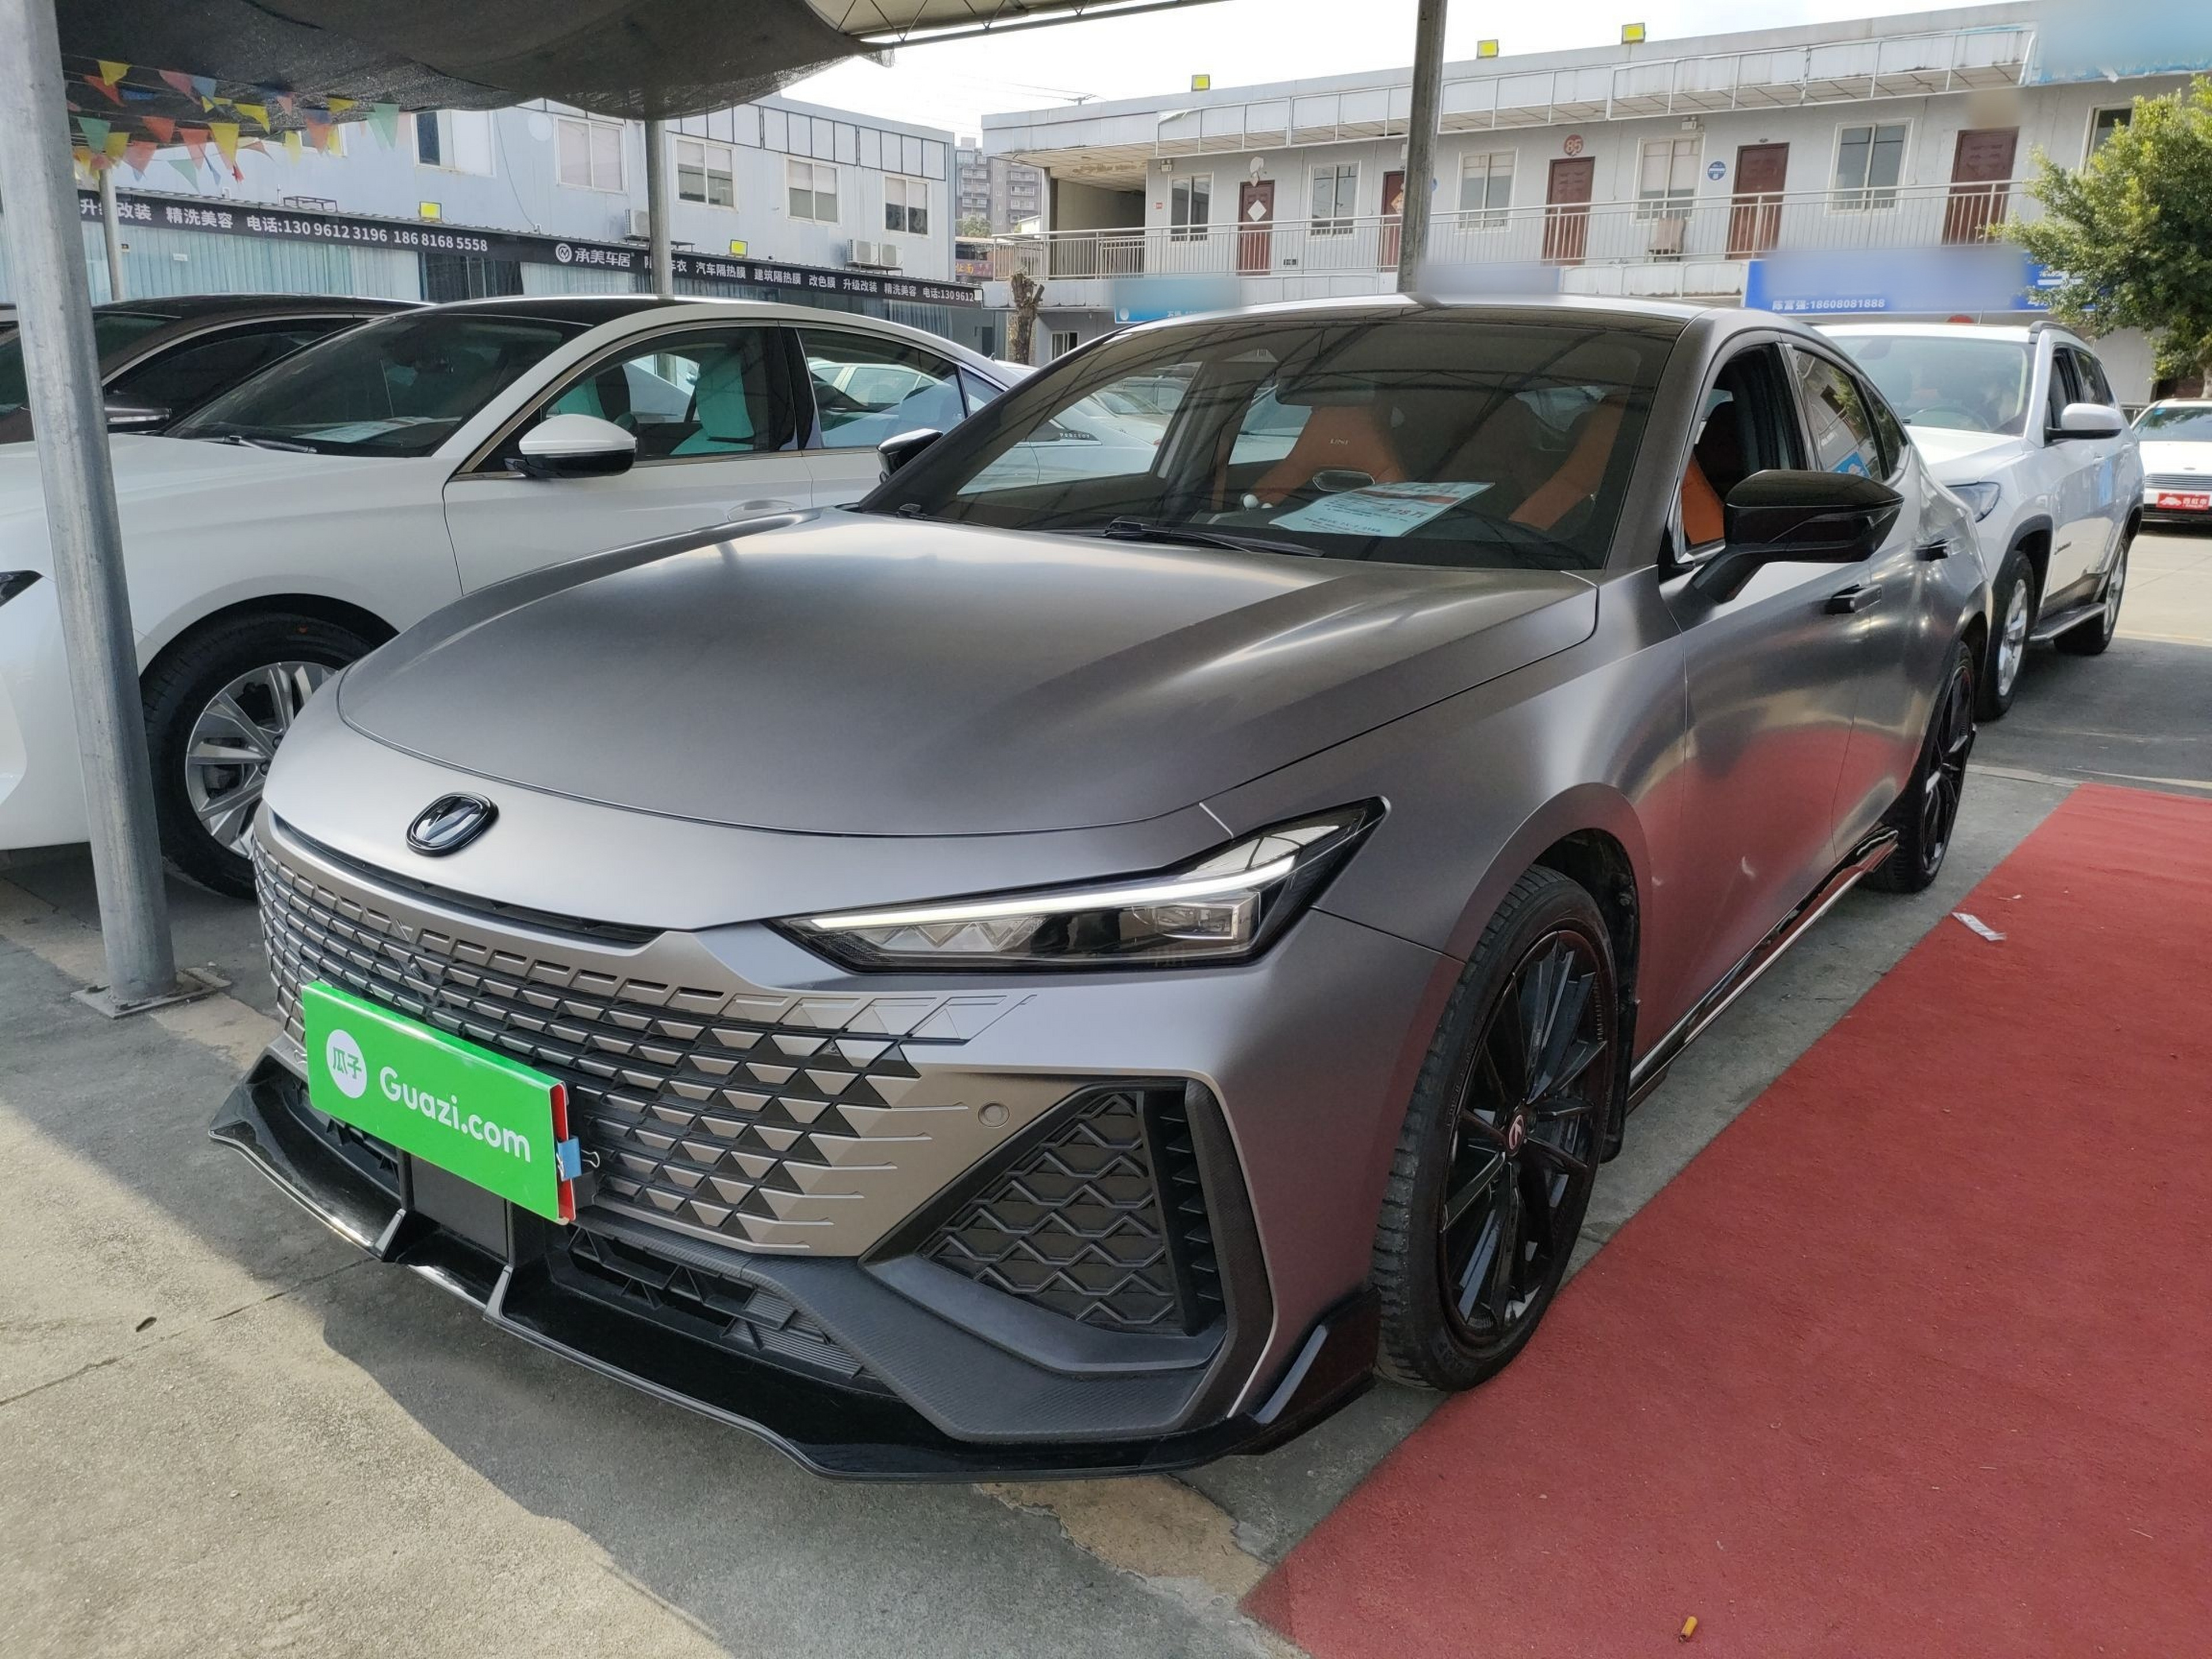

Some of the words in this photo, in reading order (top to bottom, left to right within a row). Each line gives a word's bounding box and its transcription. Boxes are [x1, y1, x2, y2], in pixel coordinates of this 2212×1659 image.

[166, 206, 234, 230] 精洗美容
[247, 214, 311, 235] 电话:130
[313, 222, 350, 239] 9612
[353, 226, 388, 242] 3196
[394, 230, 419, 245] 186
[421, 233, 454, 248] 8168
[456, 237, 488, 252] 5558
[575, 247, 630, 267] 承美车居
[695, 261, 747, 279] 汽车隔热膜
[753, 268, 801, 285] 建筑隔热膜
[808, 274, 836, 289] 改色膜
[843, 278, 877, 293] 升级改装
[884, 282, 917, 297] 精洗美容
[332, 1046, 362, 1080] 瓜子
[380, 1066, 531, 1163] Guazi.com
